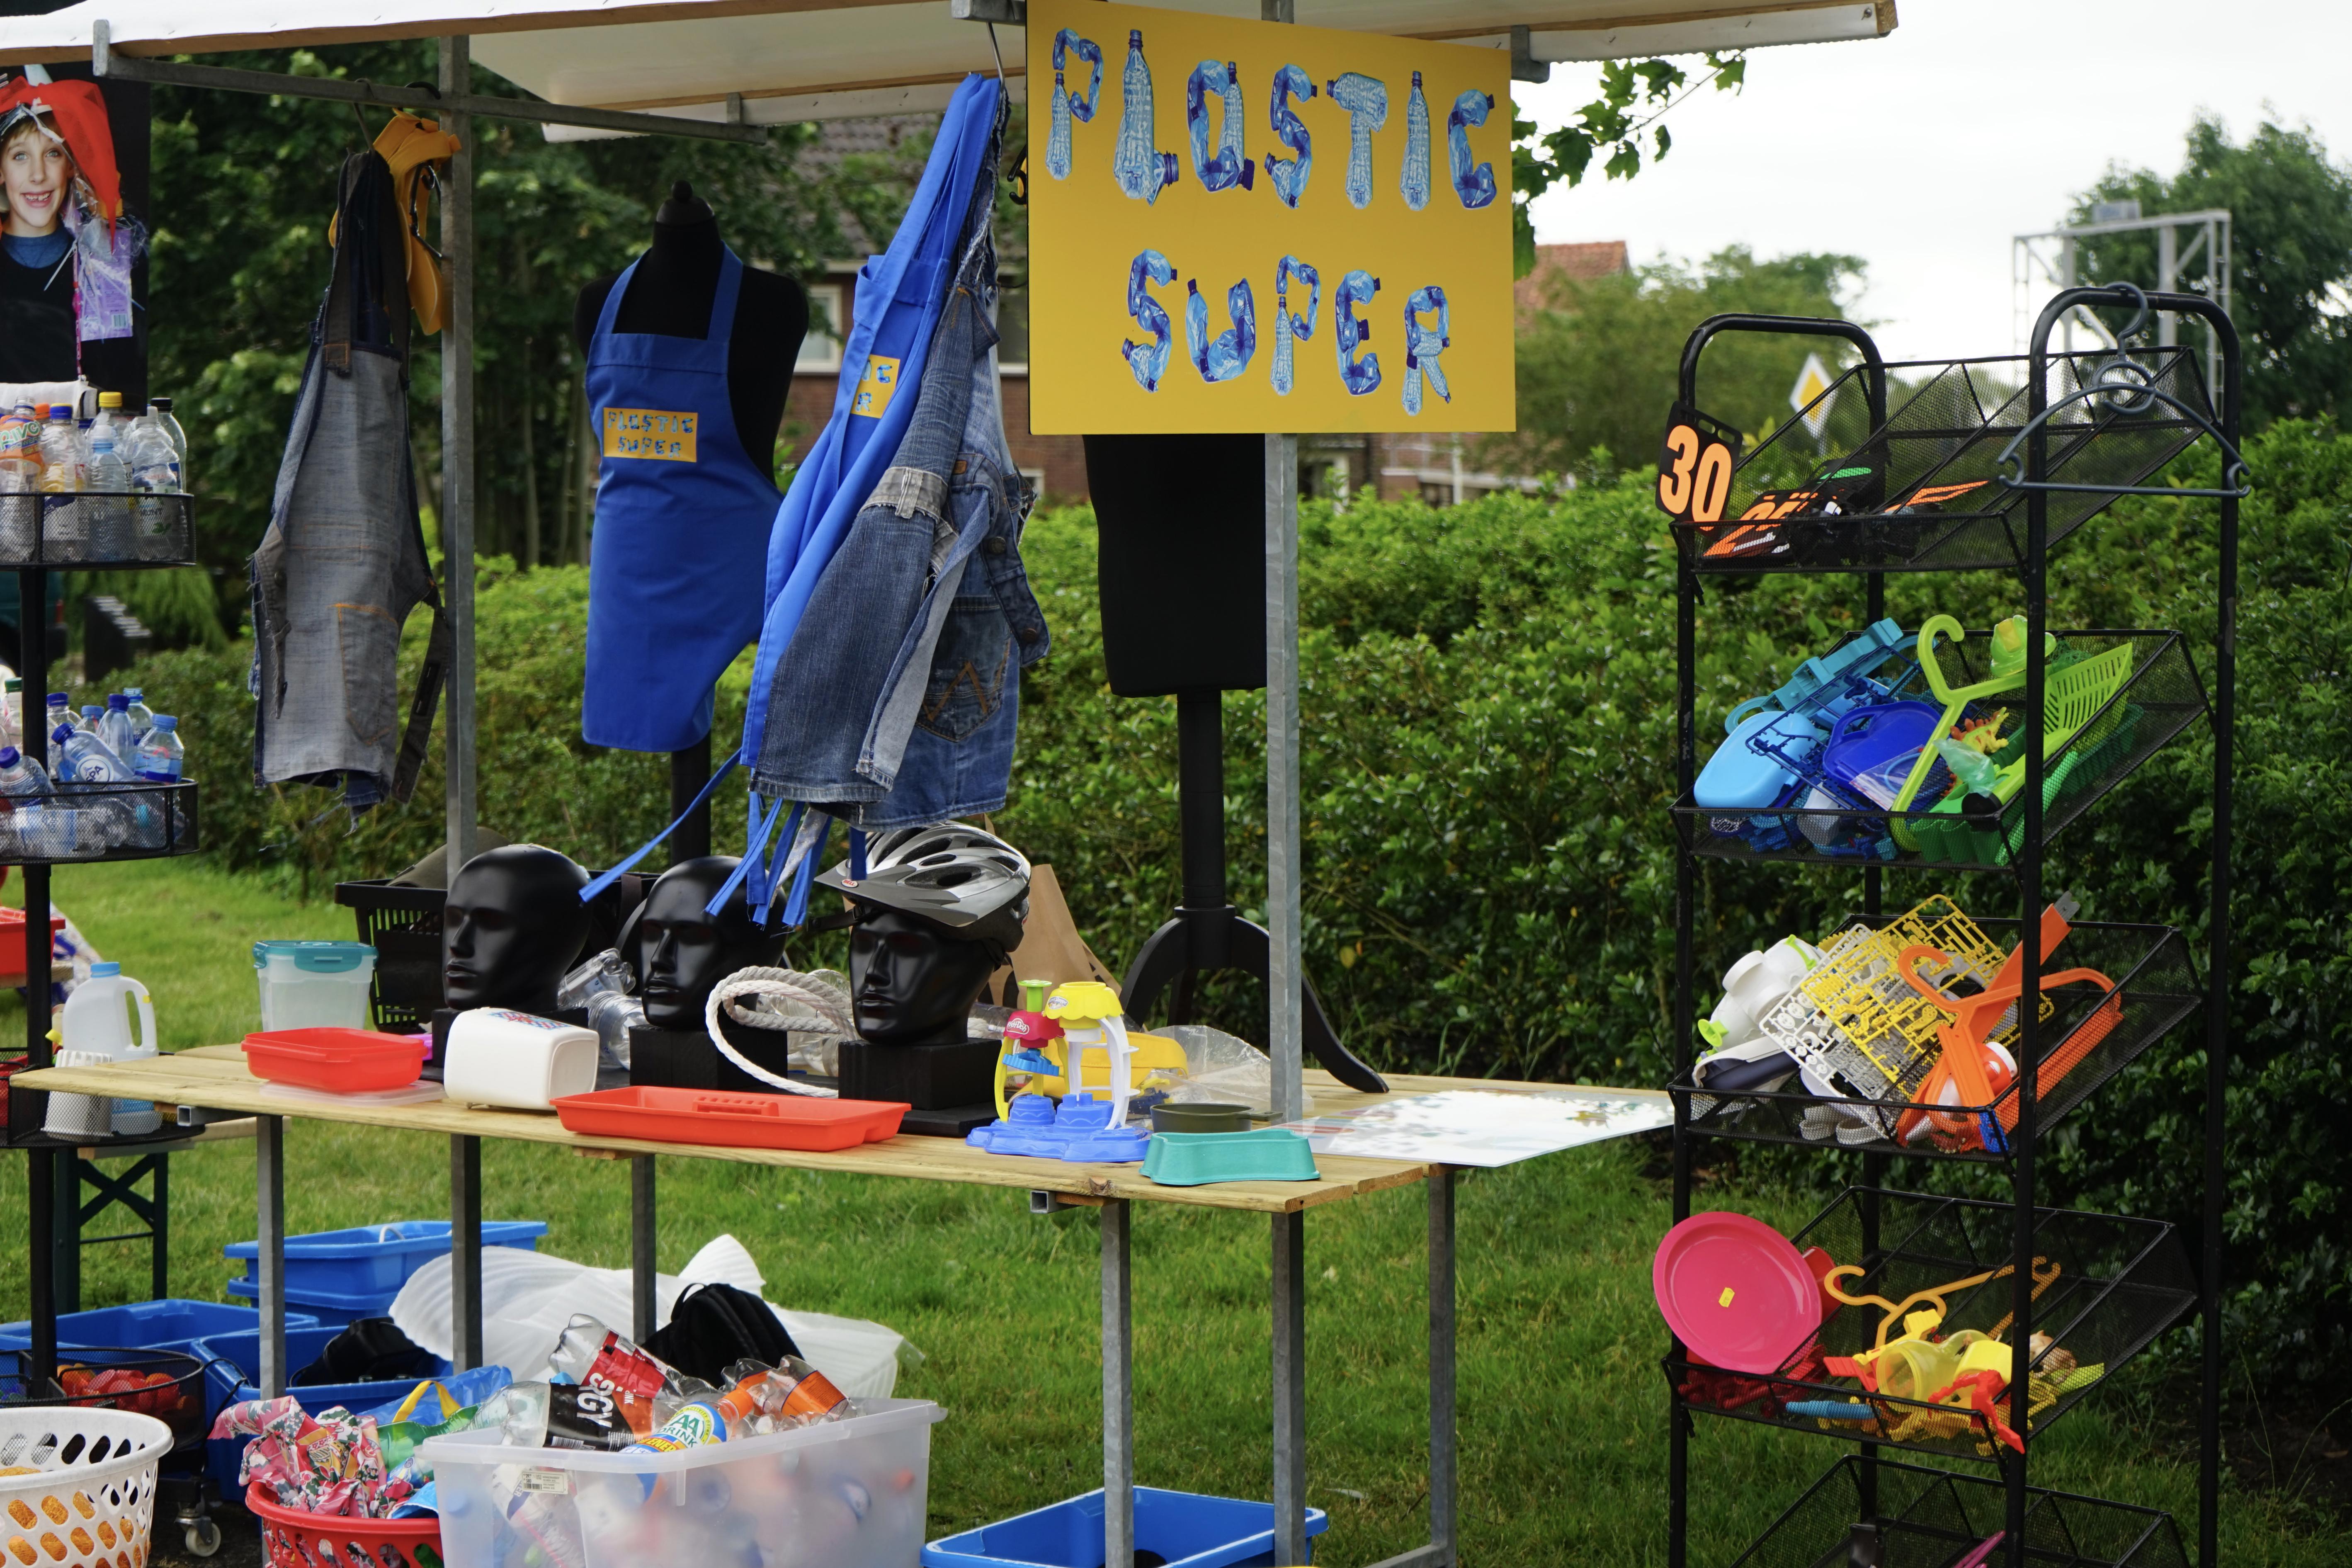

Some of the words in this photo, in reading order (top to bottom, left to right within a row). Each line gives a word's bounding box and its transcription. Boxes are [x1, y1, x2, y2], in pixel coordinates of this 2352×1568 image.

[1046, 27, 1496, 211] PLASTIC
[1121, 249, 1451, 416] SUPER
[607, 411, 693, 433] PLASTIC
[618, 436, 681, 458] SUPER
[1660, 425, 1732, 531] 30
[86, 765, 104, 782] SPA
[656, 1426, 697, 1448] DRINK
[669, 1415, 700, 1438] AA
